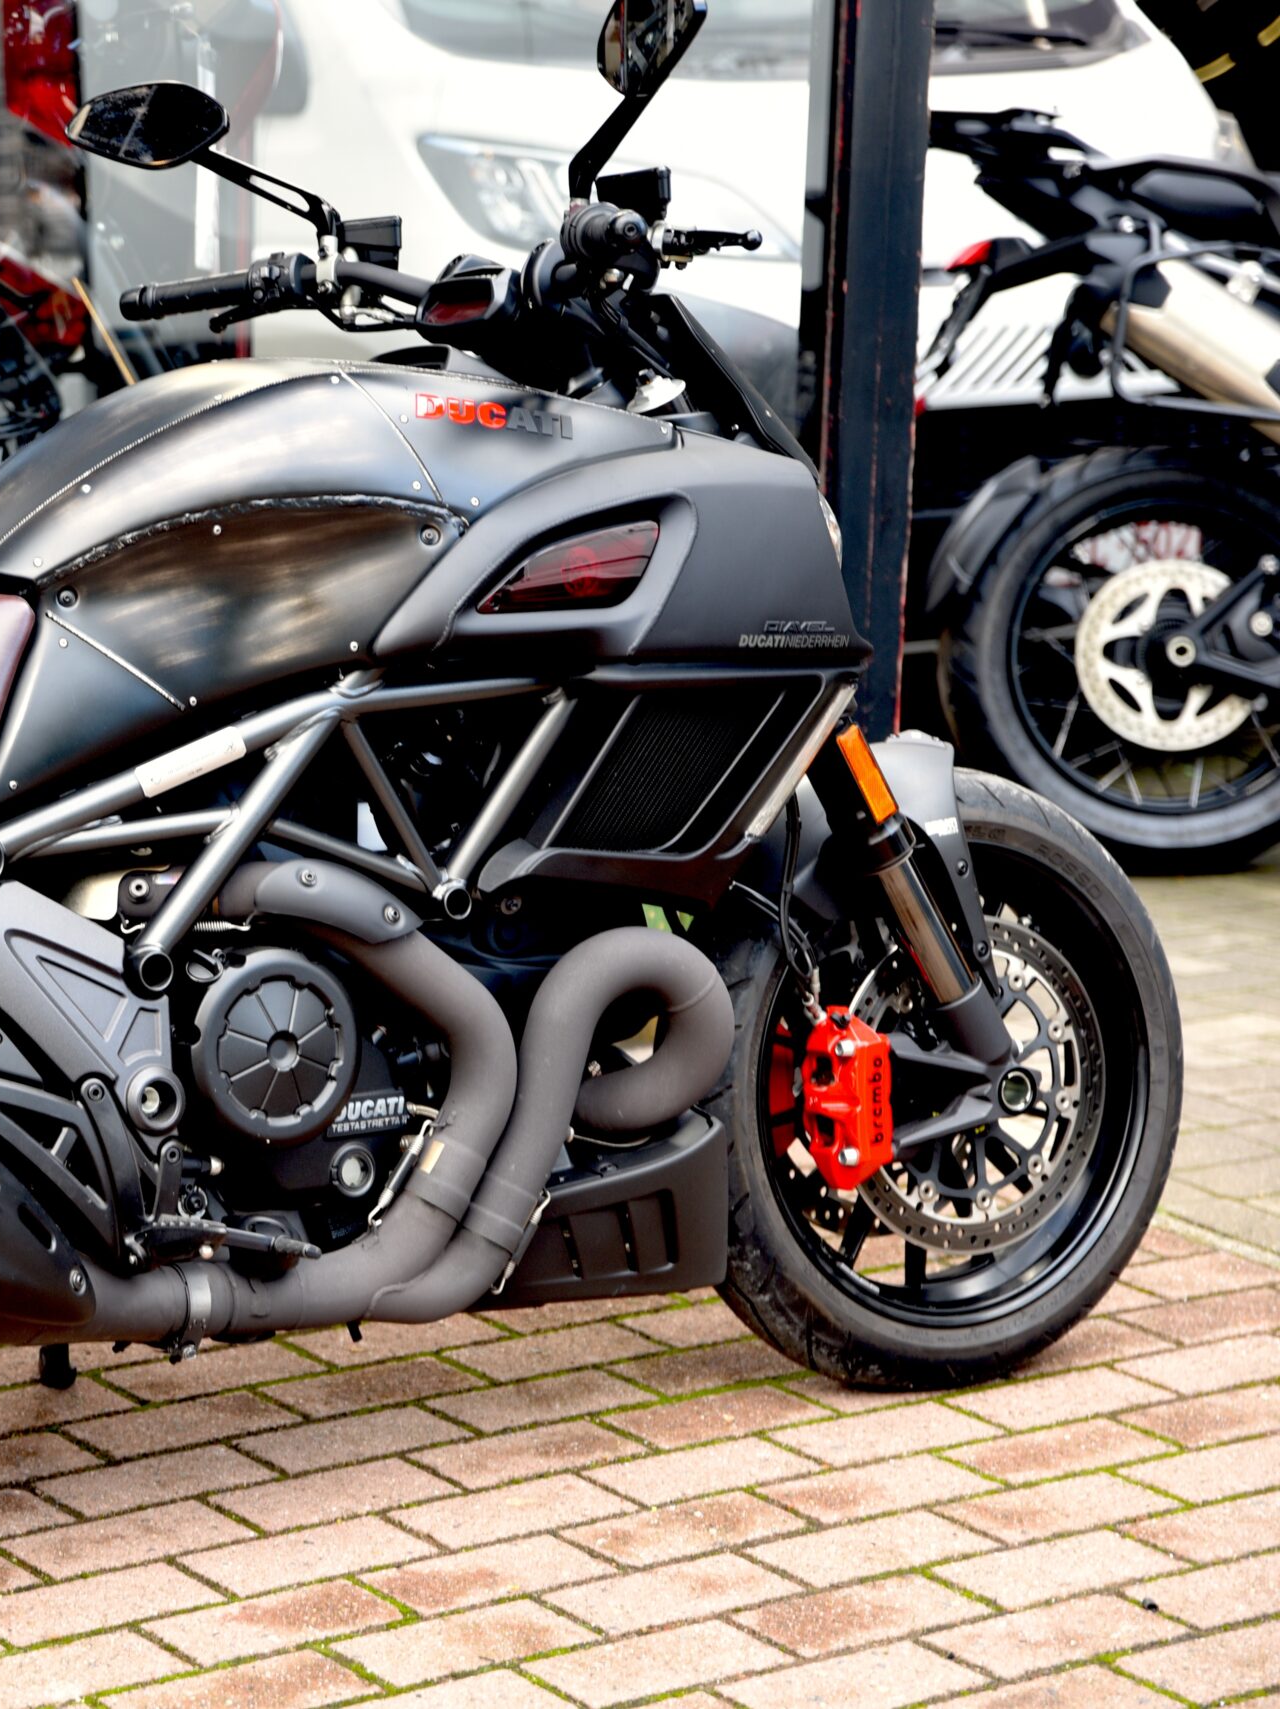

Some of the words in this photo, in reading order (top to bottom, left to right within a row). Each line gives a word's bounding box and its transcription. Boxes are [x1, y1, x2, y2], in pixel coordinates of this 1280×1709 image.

[415, 393, 574, 440] DUCATI
[870, 1057, 884, 1144] brembo
[331, 1115, 400, 1134] TESTASTRETTA
